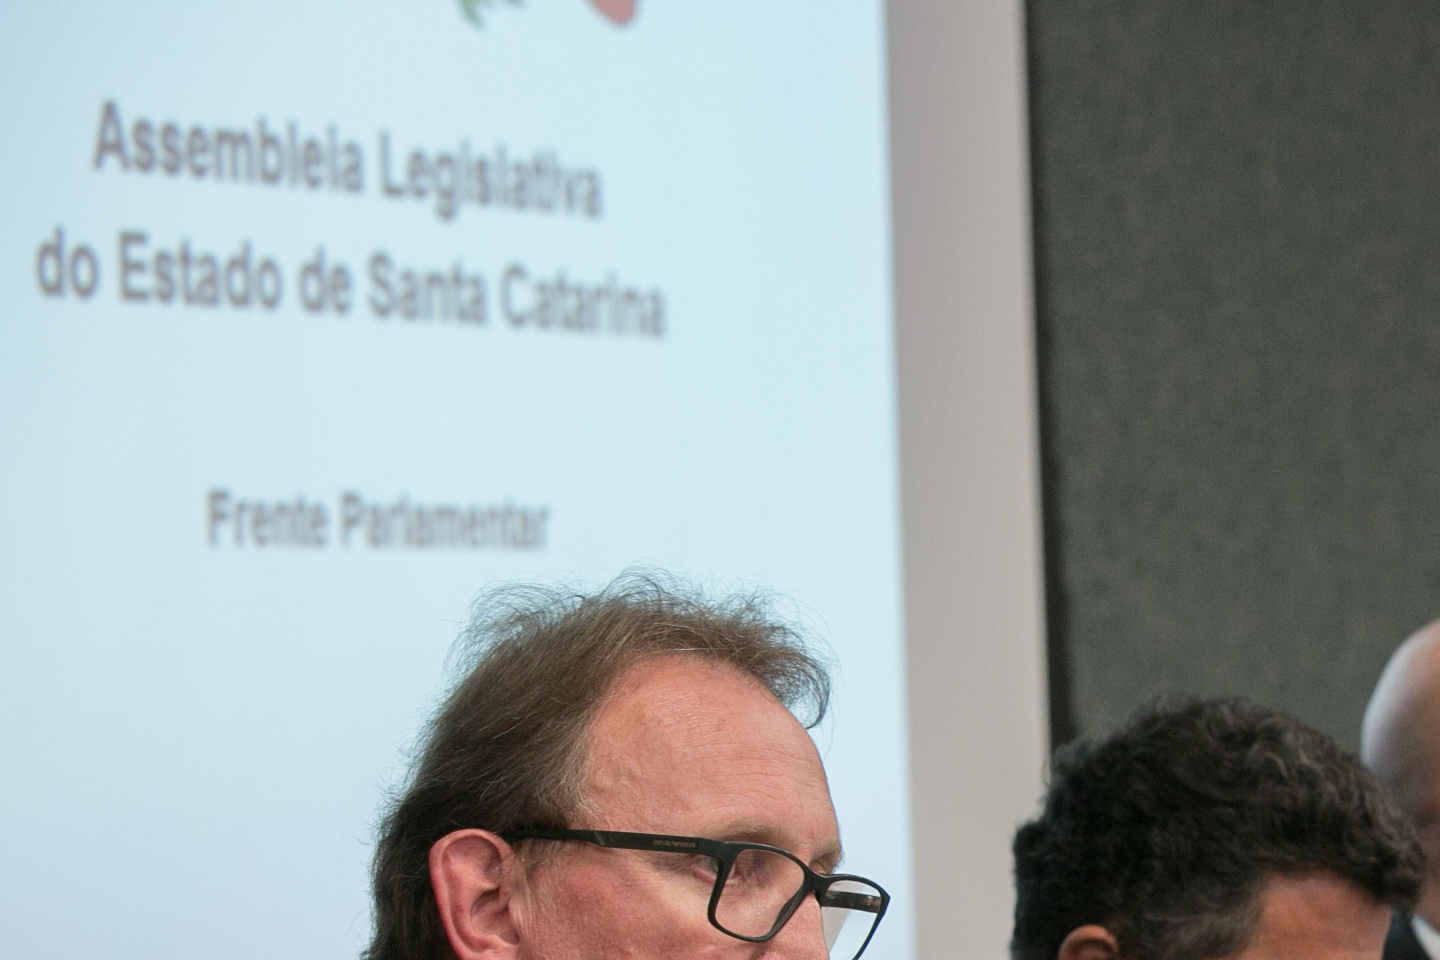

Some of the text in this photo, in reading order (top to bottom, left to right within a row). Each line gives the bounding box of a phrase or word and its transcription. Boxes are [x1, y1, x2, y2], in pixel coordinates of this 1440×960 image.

[93, 98, 604, 221] Assembleia Legislativa
[35, 225, 667, 339] do Estado de Santa Catarina
[206, 489, 550, 550] Frente Parlamentar
